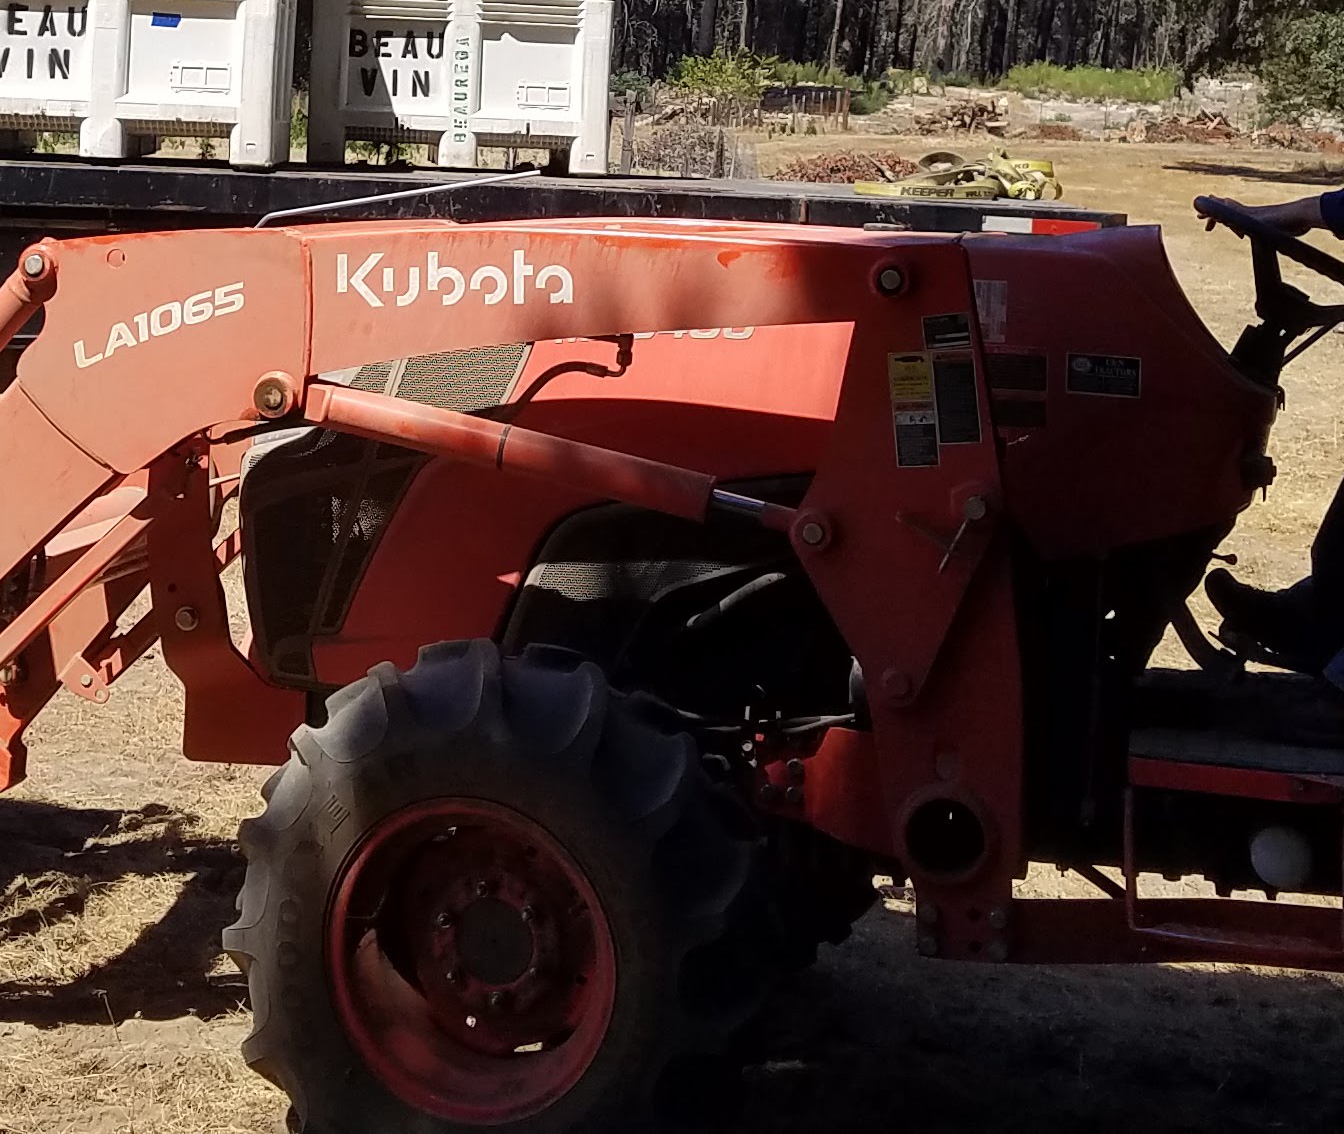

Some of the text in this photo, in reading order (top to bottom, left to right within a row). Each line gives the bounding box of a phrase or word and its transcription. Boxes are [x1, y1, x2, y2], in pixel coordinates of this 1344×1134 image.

[349, 28, 444, 59] BEAU
[360, 67, 431, 97] VIN
[900, 186, 955, 197] KEEPER
[335, 249, 574, 307] Kubota
[72, 281, 245, 369] LA1065
